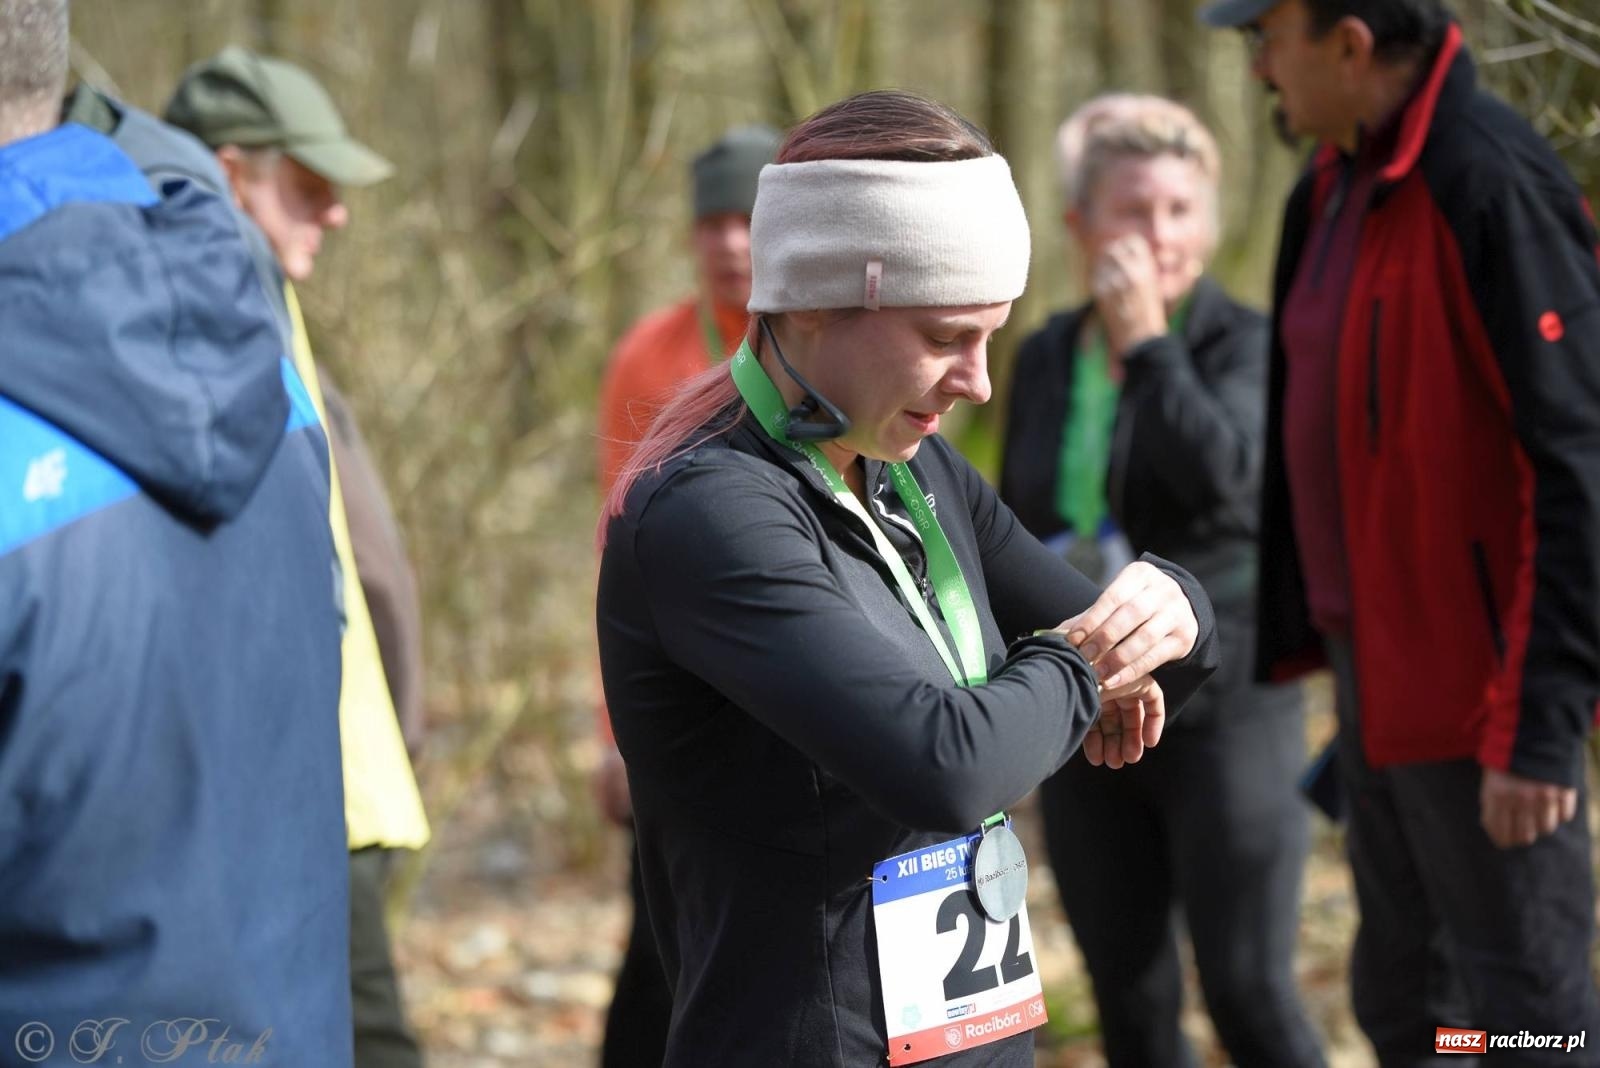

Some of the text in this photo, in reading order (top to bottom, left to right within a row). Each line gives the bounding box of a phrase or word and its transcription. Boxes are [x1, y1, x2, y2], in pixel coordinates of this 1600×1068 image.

[898, 855, 918, 878] XII
[921, 847, 957, 873] BIEG
[945, 867, 958, 881] 25
[936, 889, 1034, 1001] 22
[965, 1012, 1022, 1038] Racibórz
